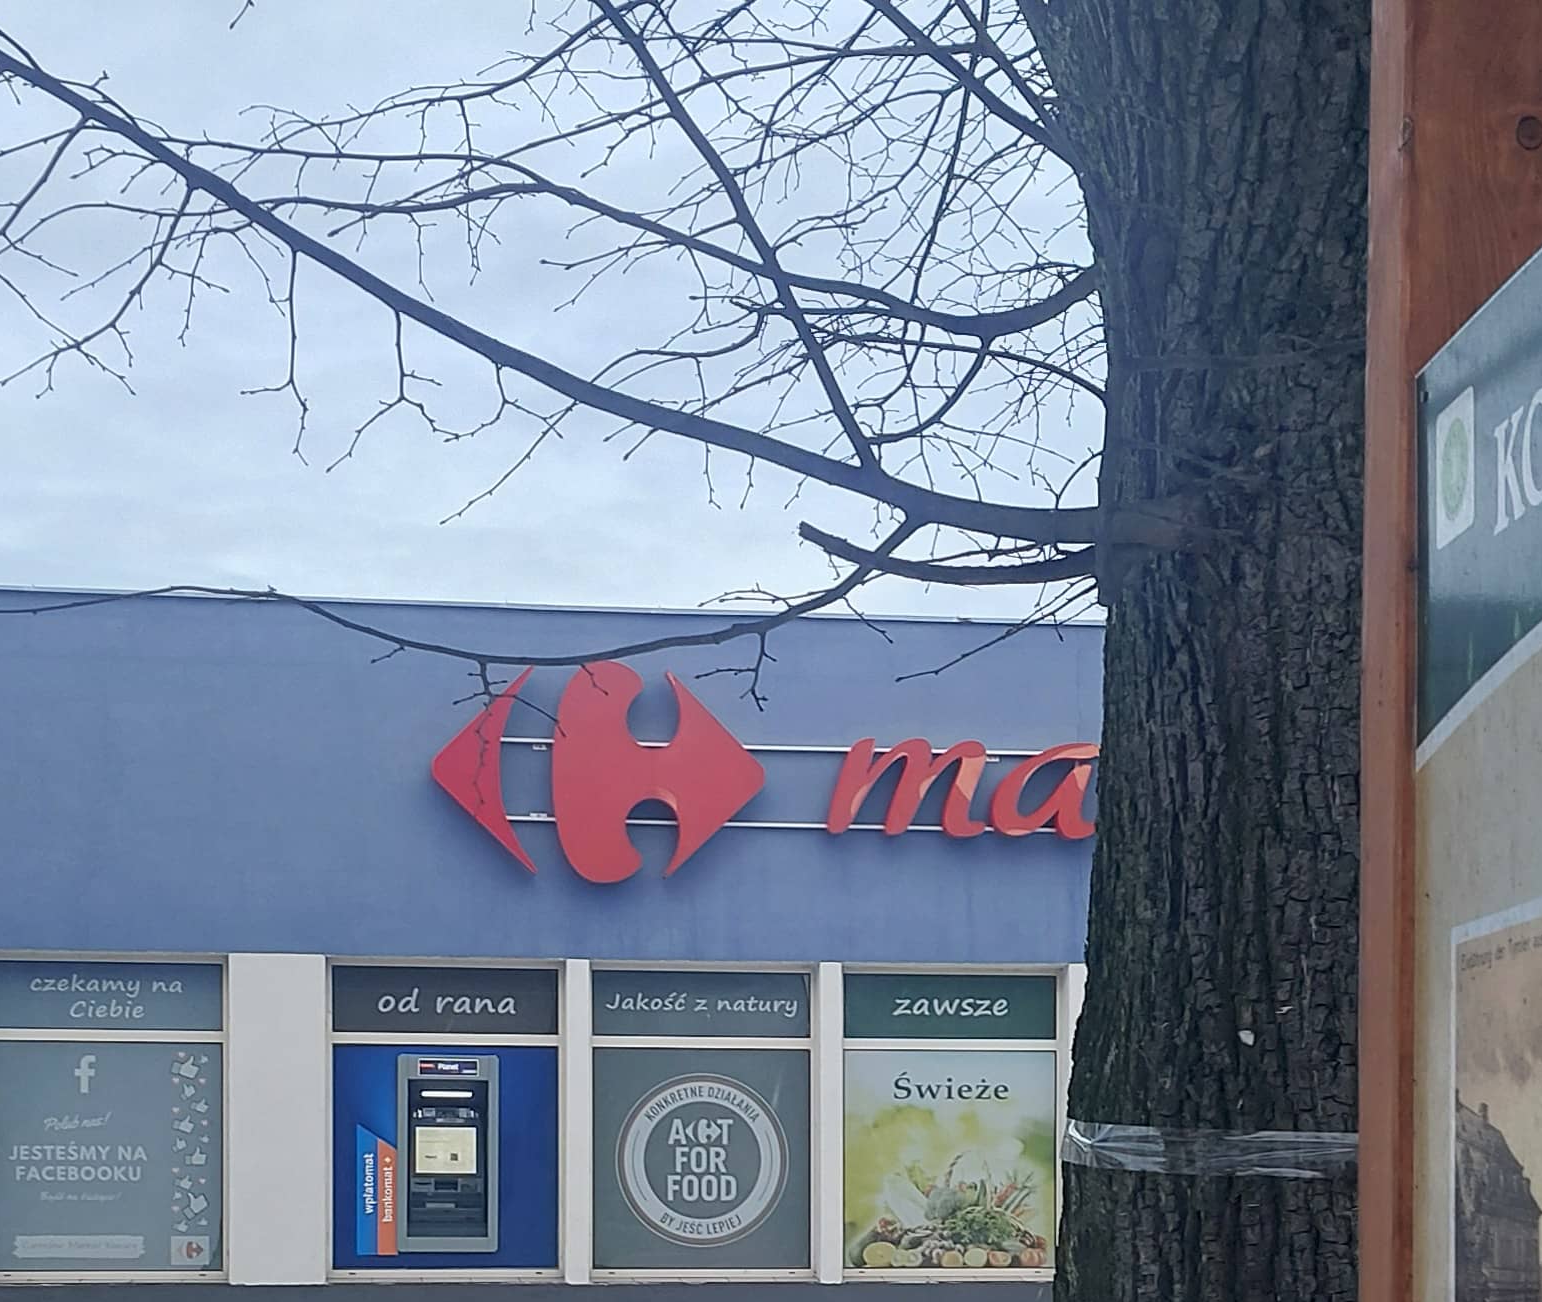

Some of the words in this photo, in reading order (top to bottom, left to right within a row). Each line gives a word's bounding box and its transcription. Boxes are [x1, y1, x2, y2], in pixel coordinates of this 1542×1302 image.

[29, 975, 141, 998] czekamy
[151, 979, 183, 993] na
[69, 999, 145, 1019] Ciebie
[377, 988, 419, 1014] od
[435, 994, 517, 1015] rana
[606, 992, 687, 1011] Jakość
[693, 999, 709, 1012] z
[716, 996, 798, 1018] natury
[892, 996, 1009, 1017] zawsze
[893, 1071, 1010, 1100] Świeże
[644, 1085, 706, 1122] KONKRETNE
[708, 1086, 761, 1123] DZIAŁANIA
[8, 1141, 111, 1161] JESTEŚMY
[117, 1145, 148, 1161] NA
[675, 1146, 727, 1174] FOR
[15, 1165, 142, 1182] FACEBOOKU
[382, 1166, 394, 1223] bankomat
[667, 1175, 738, 1202] FOOD
[659, 1212, 675, 1227] BY
[706, 1214, 743, 1235] LEPIEJ
